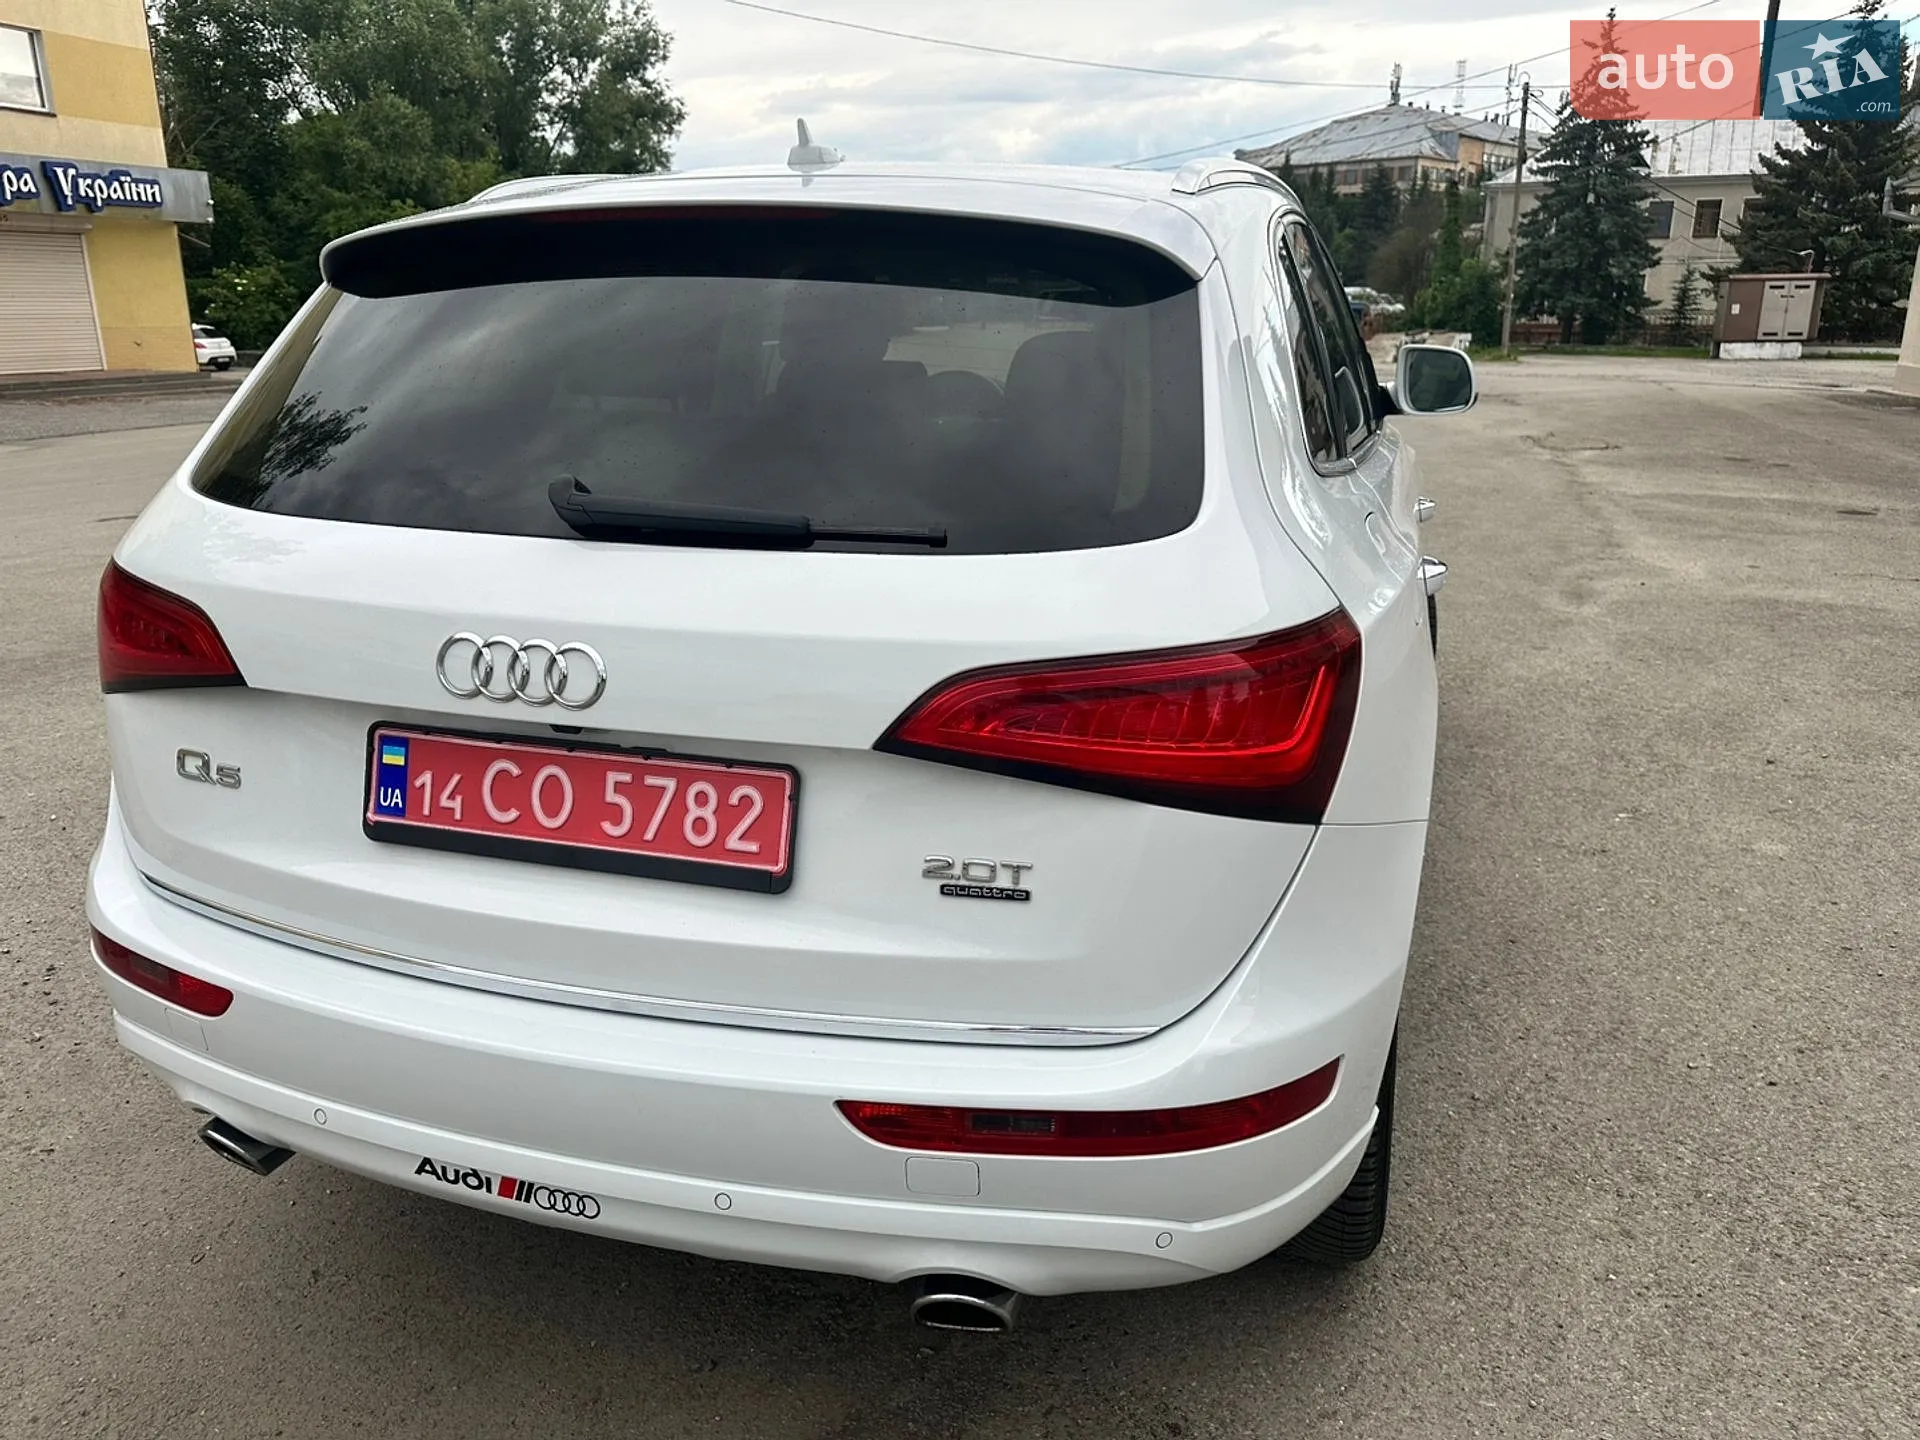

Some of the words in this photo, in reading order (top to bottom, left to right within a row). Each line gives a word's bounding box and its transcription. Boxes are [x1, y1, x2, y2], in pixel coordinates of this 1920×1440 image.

[2, 170, 37, 200] ра
[53, 166, 162, 207] України
[176, 748, 242, 790] Q5
[380, 787, 403, 808] UA
[413, 770, 463, 821] 14
[481, 759, 574, 830] CO
[600, 771, 764, 854] 5782
[922, 855, 1033, 886] 2.0T
[942, 885, 1027, 899] quattro
[414, 1157, 493, 1194] Audi
